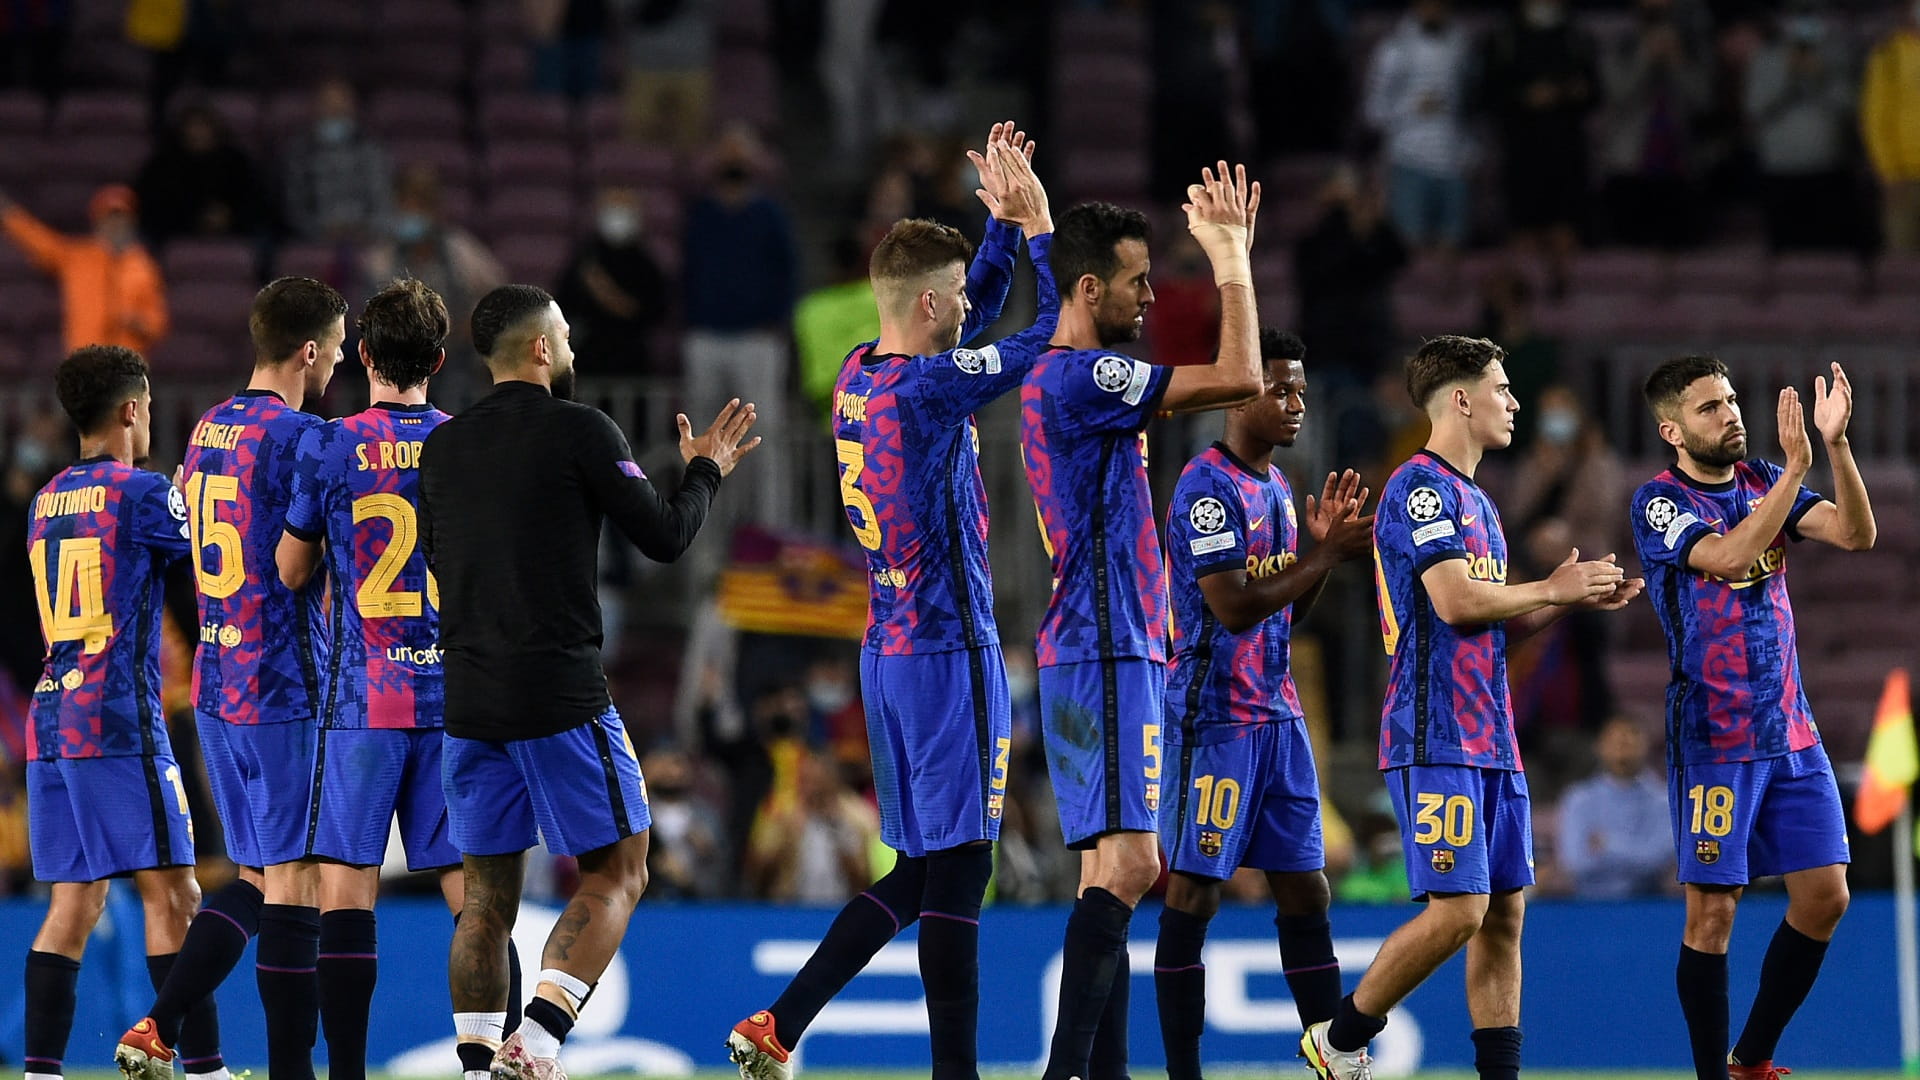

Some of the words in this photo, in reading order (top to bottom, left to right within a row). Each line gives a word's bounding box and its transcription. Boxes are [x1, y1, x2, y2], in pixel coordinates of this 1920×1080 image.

[836, 389, 872, 424] PIQUÉ
[192, 420, 245, 450] LENGLET
[836, 439, 882, 551] 3
[185, 471, 246, 599] 15
[352, 493, 440, 618] 2
[29, 537, 113, 657] 14
[991, 737, 1010, 790] 3
[1143, 724, 1161, 778] 5
[1194, 775, 1240, 829] 10
[1415, 792, 1474, 847] 30
[1688, 784, 1735, 837] 18
